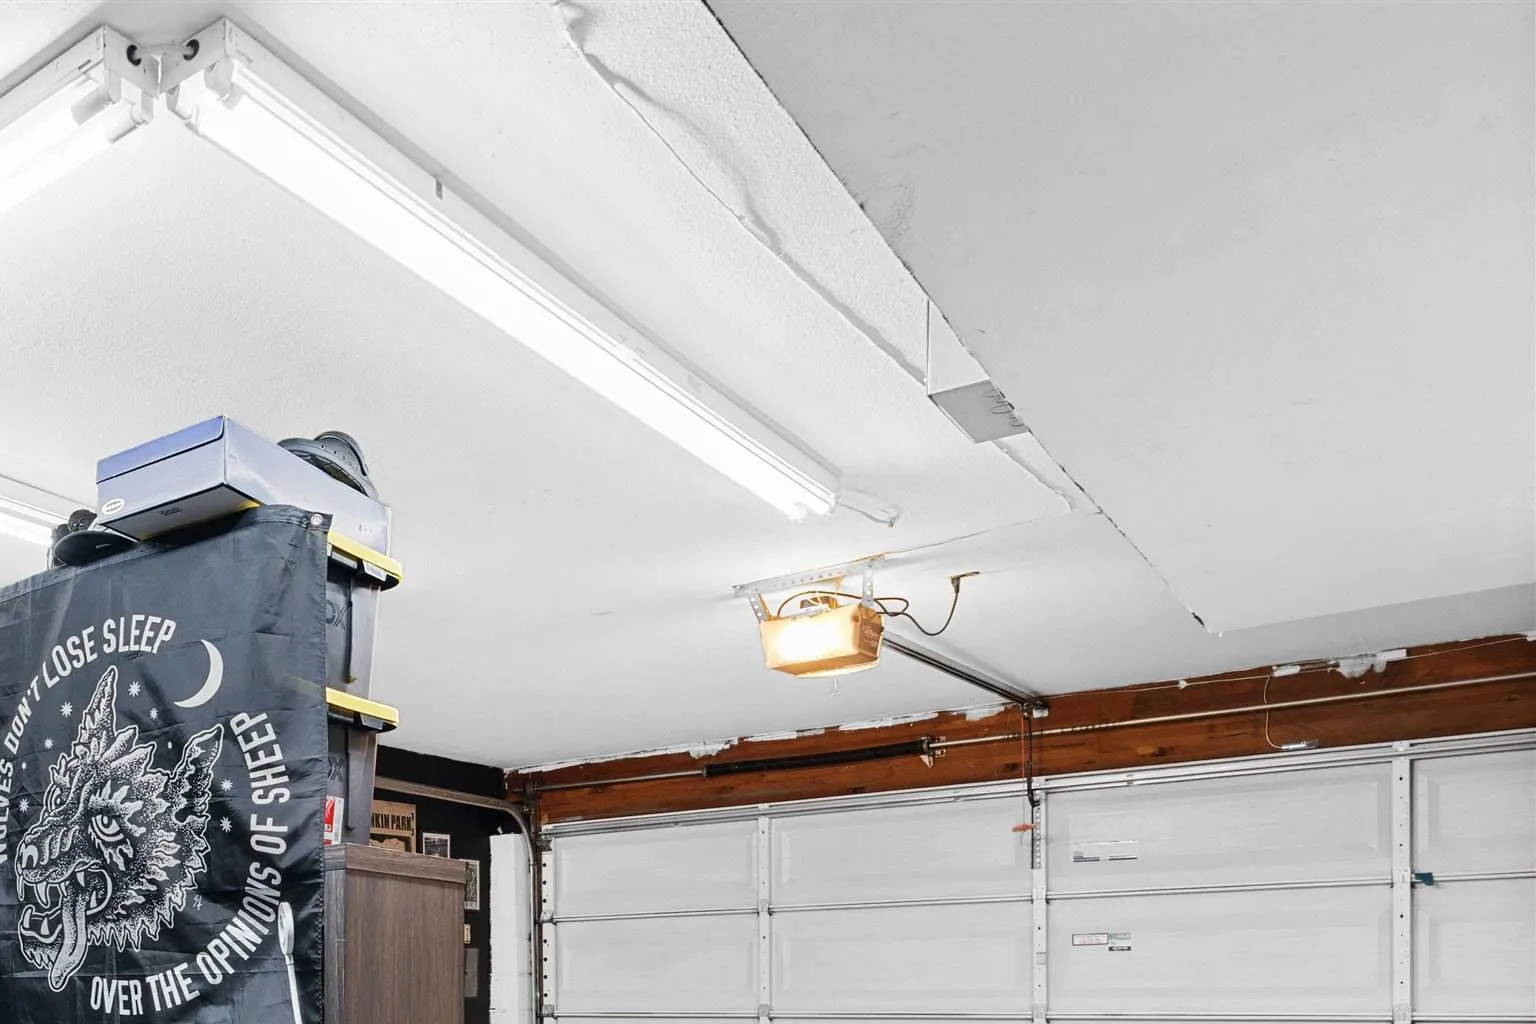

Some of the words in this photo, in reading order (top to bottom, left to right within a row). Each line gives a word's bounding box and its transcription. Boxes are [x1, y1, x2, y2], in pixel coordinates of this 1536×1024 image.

[3, 674, 43, 756] DON'T
[42, 625, 99, 691] LOSE
[101, 613, 177, 655] SLEEP
[229, 712, 292, 806] SHEEP
[250, 813, 290, 856] OF
[391, 814, 412, 832] PARK
[196, 862, 282, 986] OPINIONS
[90, 974, 144, 1017] OVER
[145, 962, 200, 1013] THE
